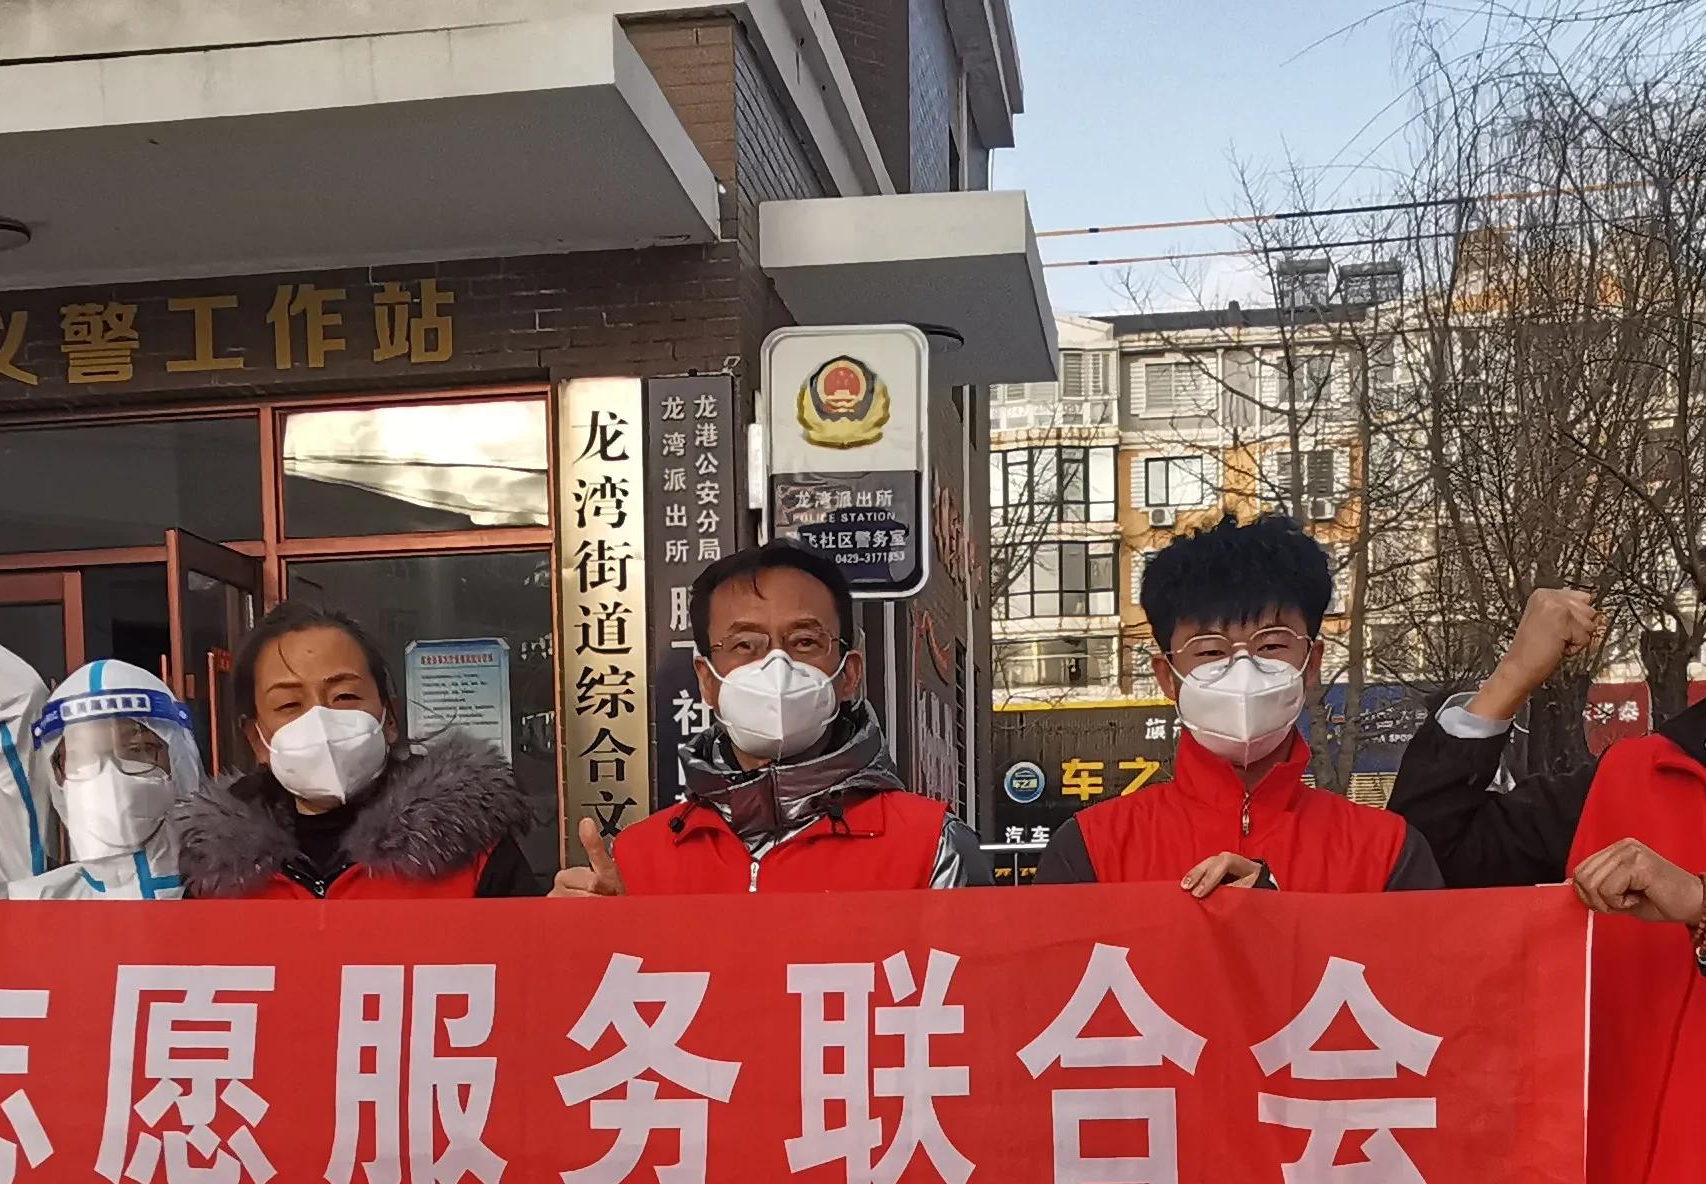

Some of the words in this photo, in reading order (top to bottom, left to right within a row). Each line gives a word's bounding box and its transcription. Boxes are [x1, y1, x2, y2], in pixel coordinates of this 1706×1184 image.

[660, 396, 690, 564] 龙湾派出所
[693, 394, 722, 562] 龙港公安分局
[794, 488, 894, 509] 龙湾派出所
[793, 512, 836, 524] POLICE
[840, 511, 896, 523] STATION
[571, 410, 638, 838] 龙湾街道综合文
[1061, 756, 1161, 801] 车之
[1005, 825, 1051, 844] 汽车
